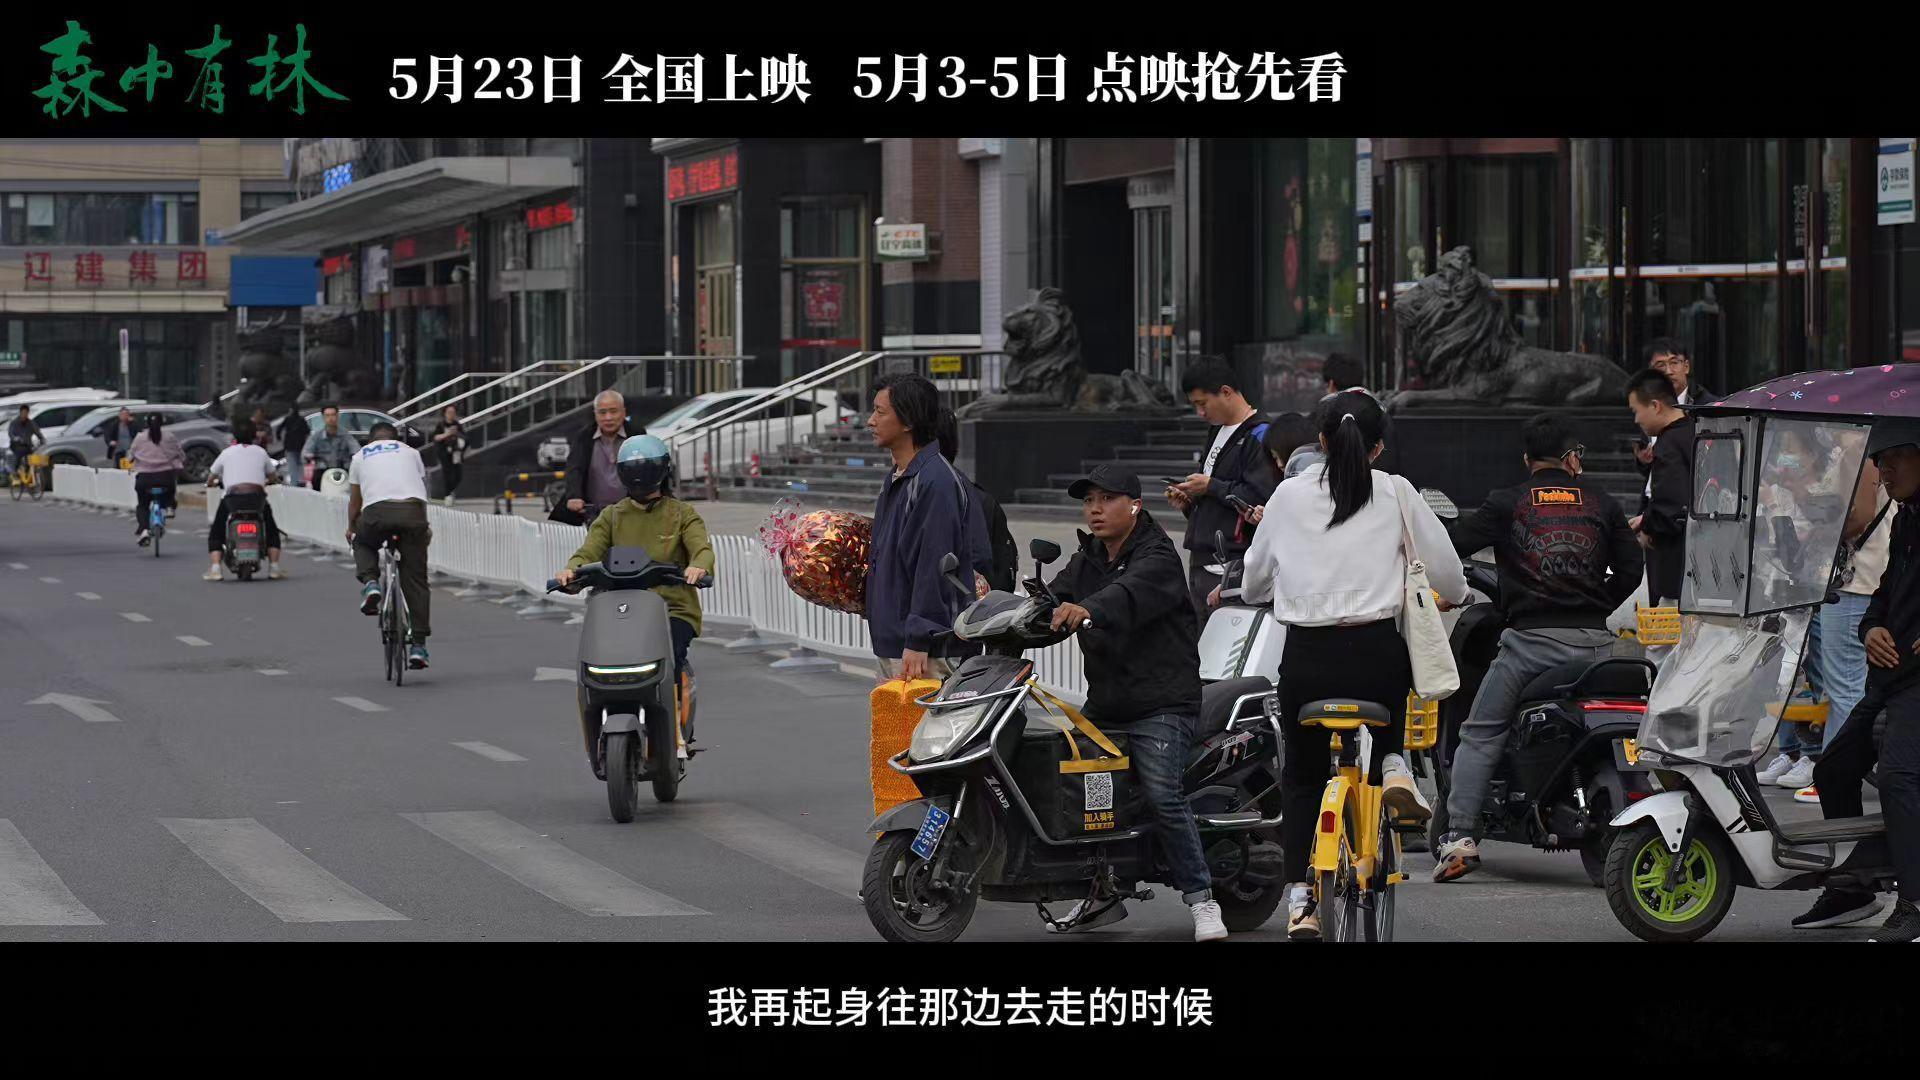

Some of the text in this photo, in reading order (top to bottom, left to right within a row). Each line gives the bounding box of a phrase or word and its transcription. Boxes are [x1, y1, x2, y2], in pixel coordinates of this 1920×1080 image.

[25, 252, 208, 283] 辽建集团
[918, 810, 942, 852] 314657
